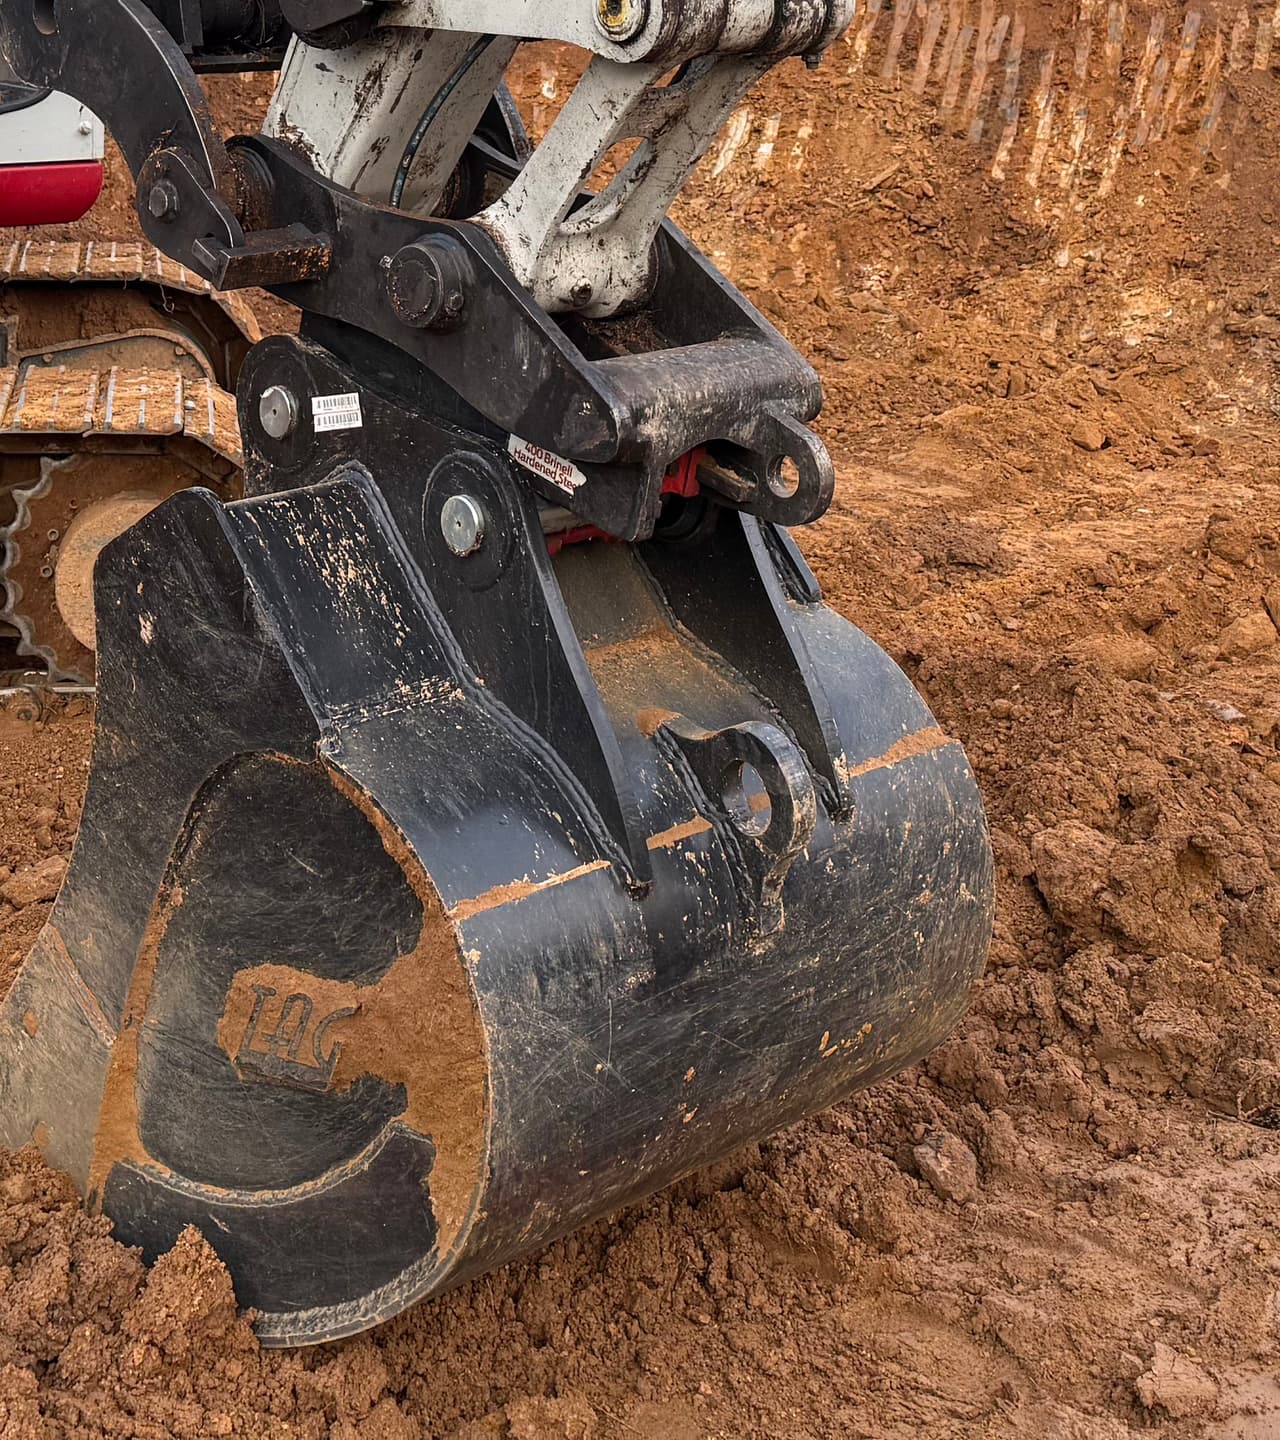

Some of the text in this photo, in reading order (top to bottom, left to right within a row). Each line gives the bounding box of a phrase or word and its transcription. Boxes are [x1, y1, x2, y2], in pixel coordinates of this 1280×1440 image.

[513, 447, 559, 481] Hardened
[524, 442, 574, 478] 400 Brinell
